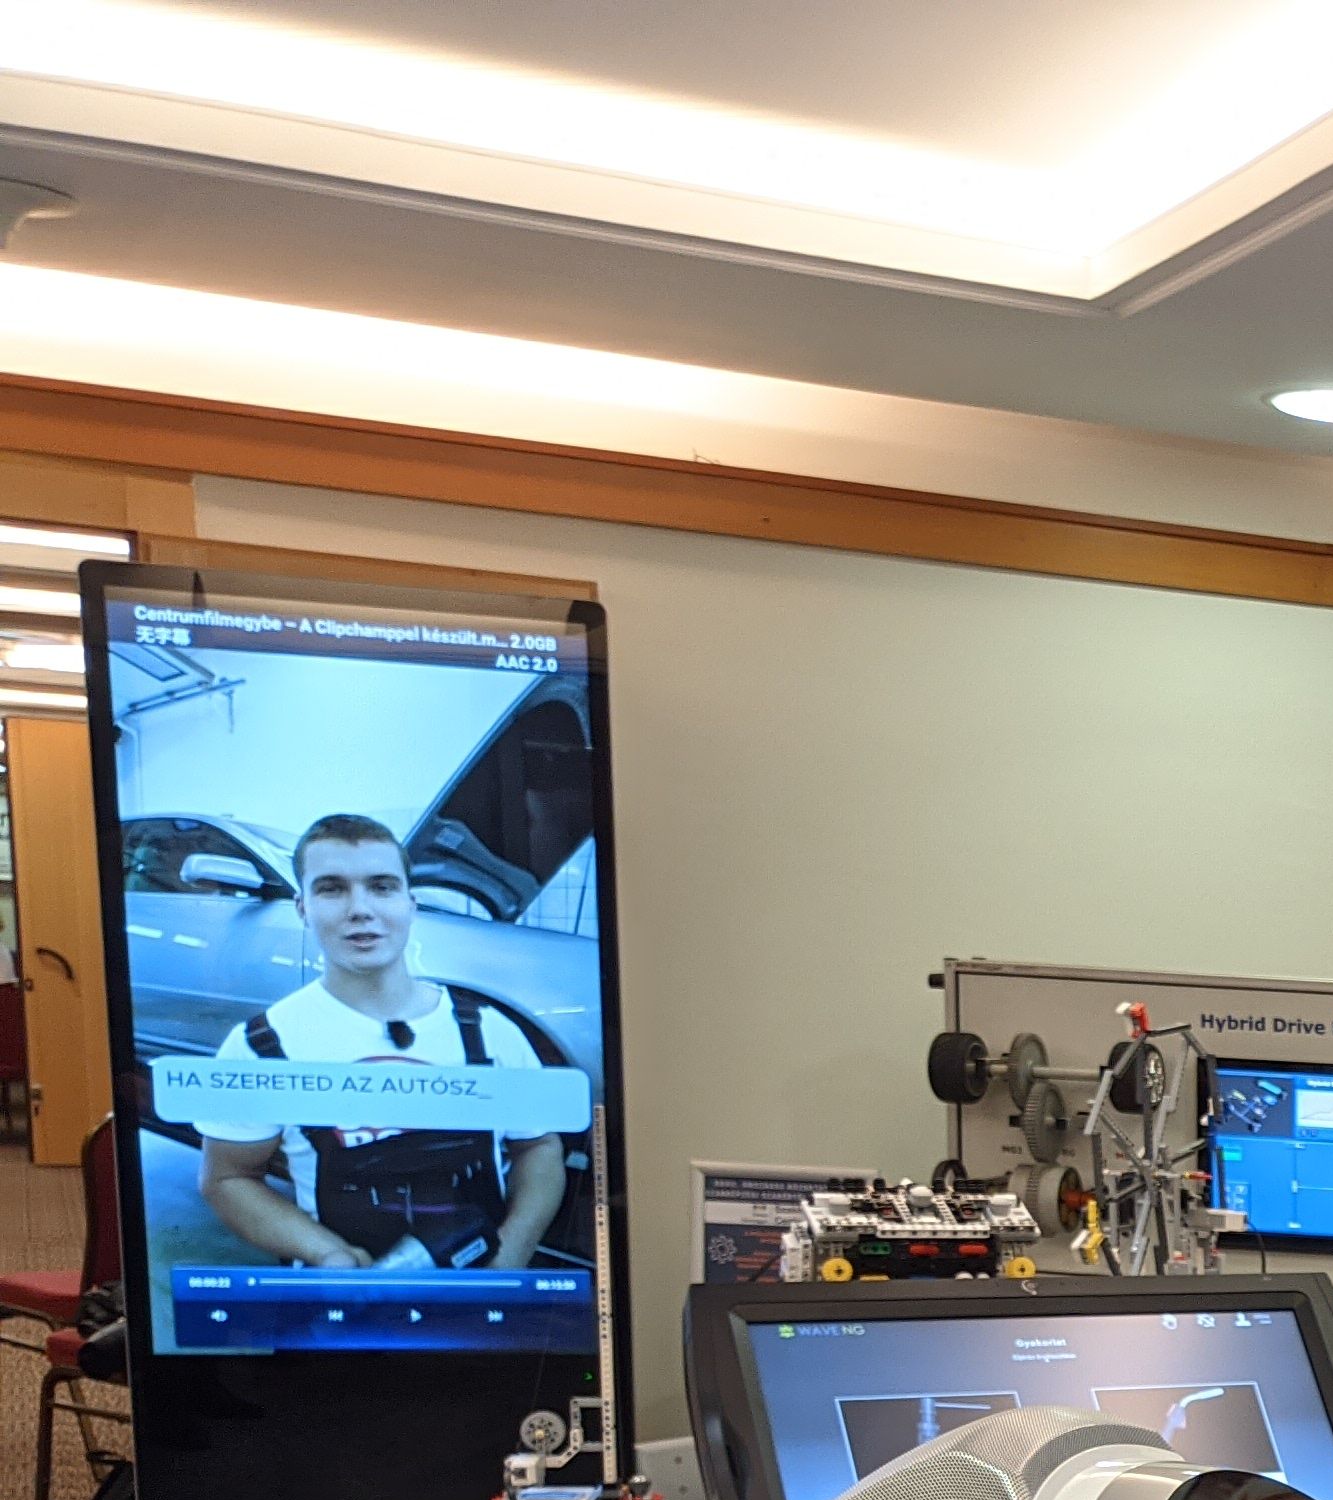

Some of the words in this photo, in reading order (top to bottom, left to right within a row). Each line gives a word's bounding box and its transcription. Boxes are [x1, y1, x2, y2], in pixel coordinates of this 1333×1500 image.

[496, 654, 530, 670] AAC
[533, 657, 557, 672] 2.0
[1201, 1014, 1266, 1032] Hybrid
[1273, 1018, 1325, 1035] Drive
[166, 1070, 201, 1089] HA
[210, 1073, 332, 1092] SZERETED
[341, 1077, 372, 1094] AZ
